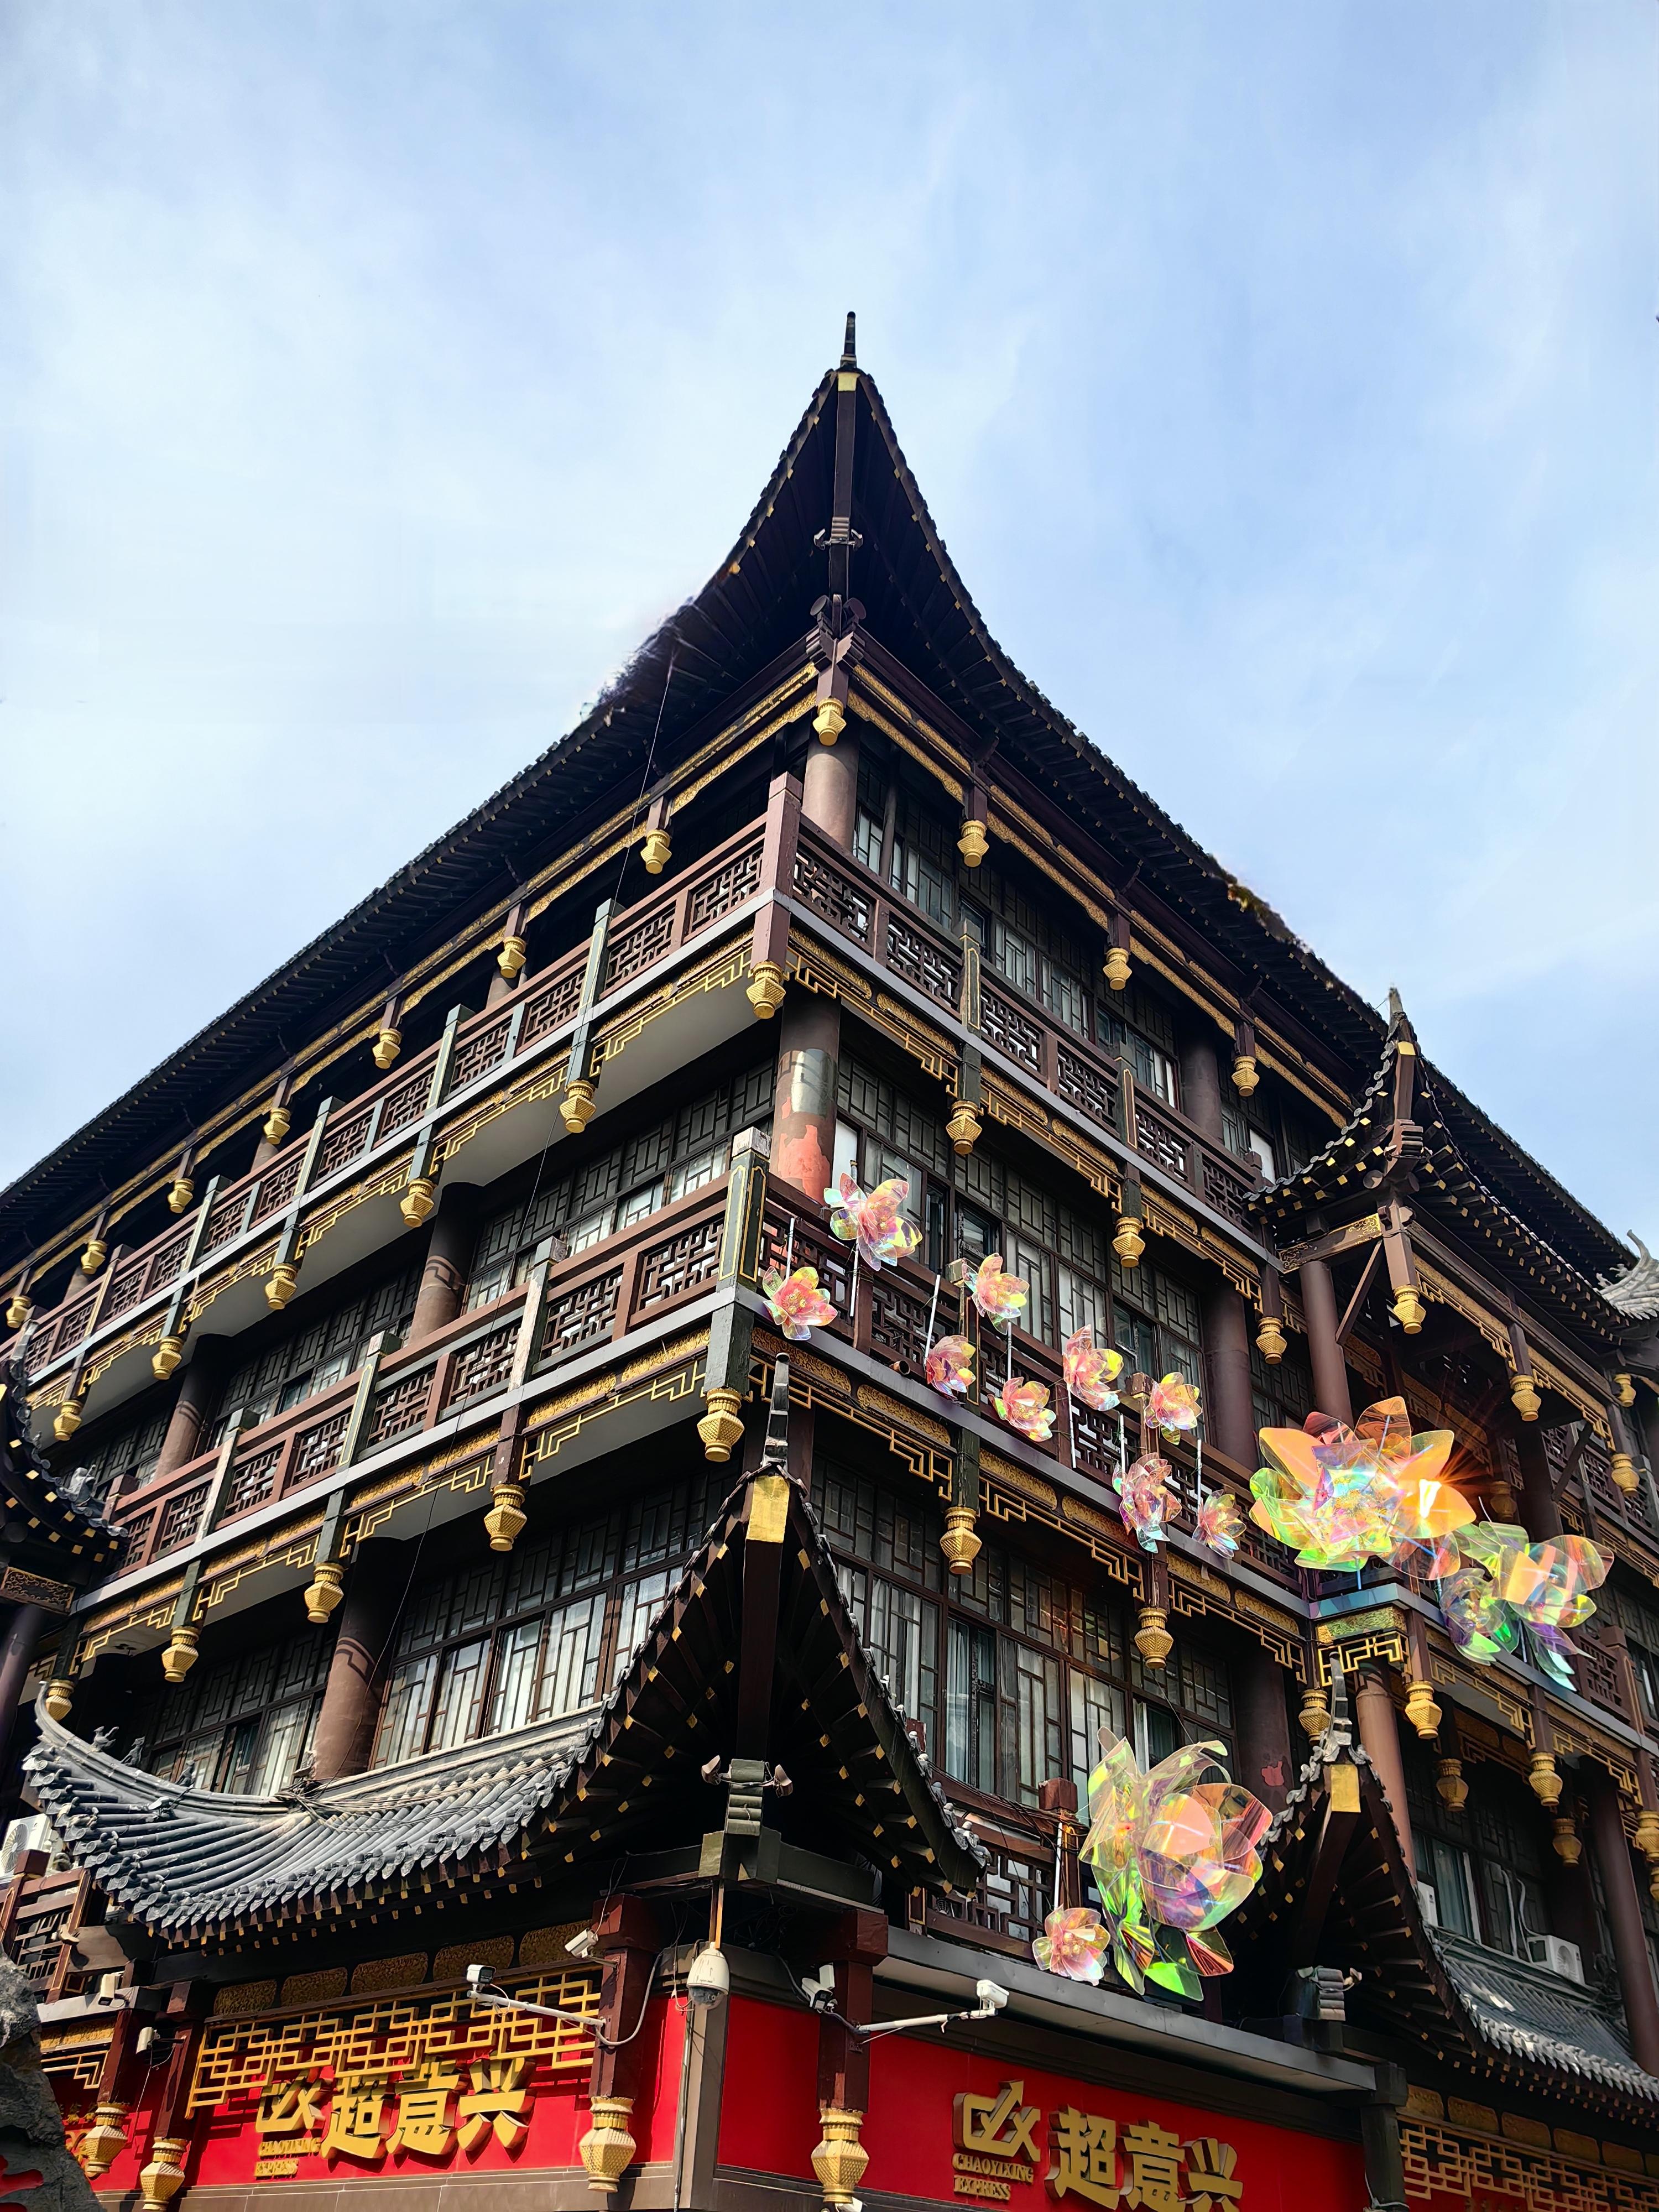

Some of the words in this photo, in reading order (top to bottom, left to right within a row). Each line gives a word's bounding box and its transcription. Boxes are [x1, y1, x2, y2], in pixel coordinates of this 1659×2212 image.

[320, 2057, 529, 2159] 超意兴
[952, 2153, 1034, 2183] CHAOYIXING
[953, 2174, 1011, 2200] EXPRESS
[1046, 2104, 1244, 2212] 超意兴
